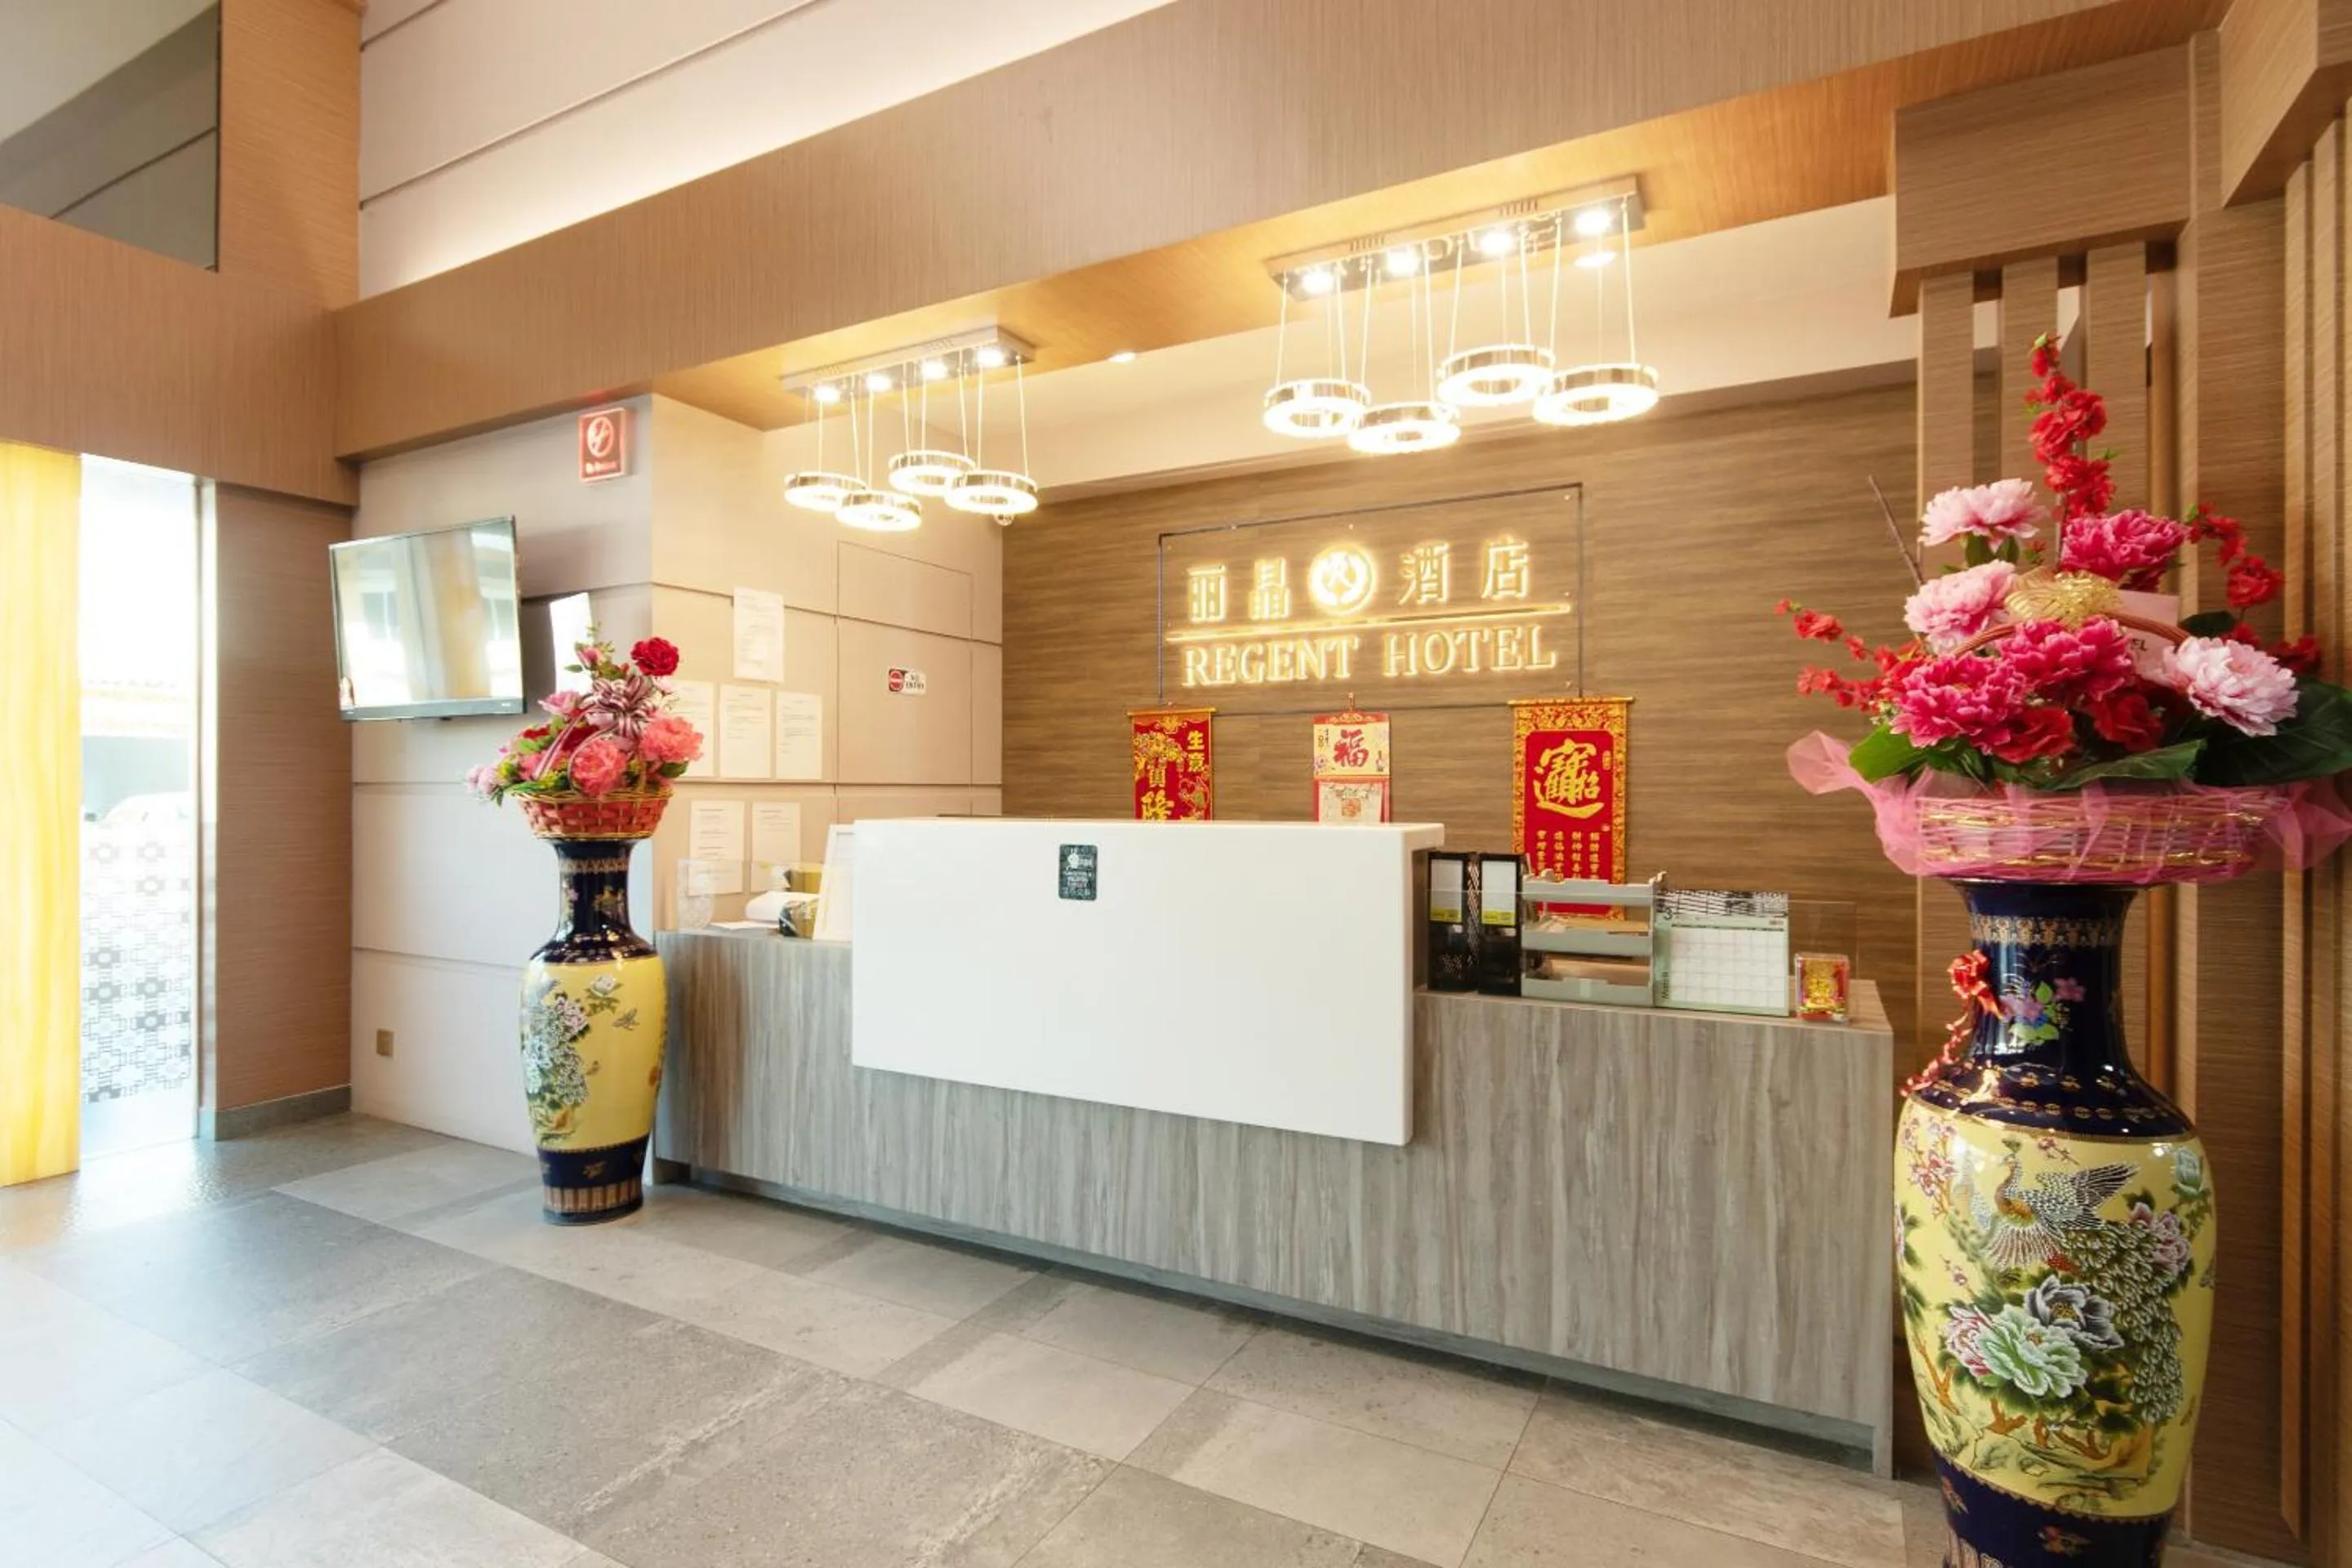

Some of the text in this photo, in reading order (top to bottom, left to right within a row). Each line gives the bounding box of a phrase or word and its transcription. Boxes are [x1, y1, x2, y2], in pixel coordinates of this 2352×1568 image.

[1187, 534, 1530, 624] 丽晶 酒店
[1183, 623, 1557, 688] REGENT HOTEL
[1333, 728, 1369, 768] 福
